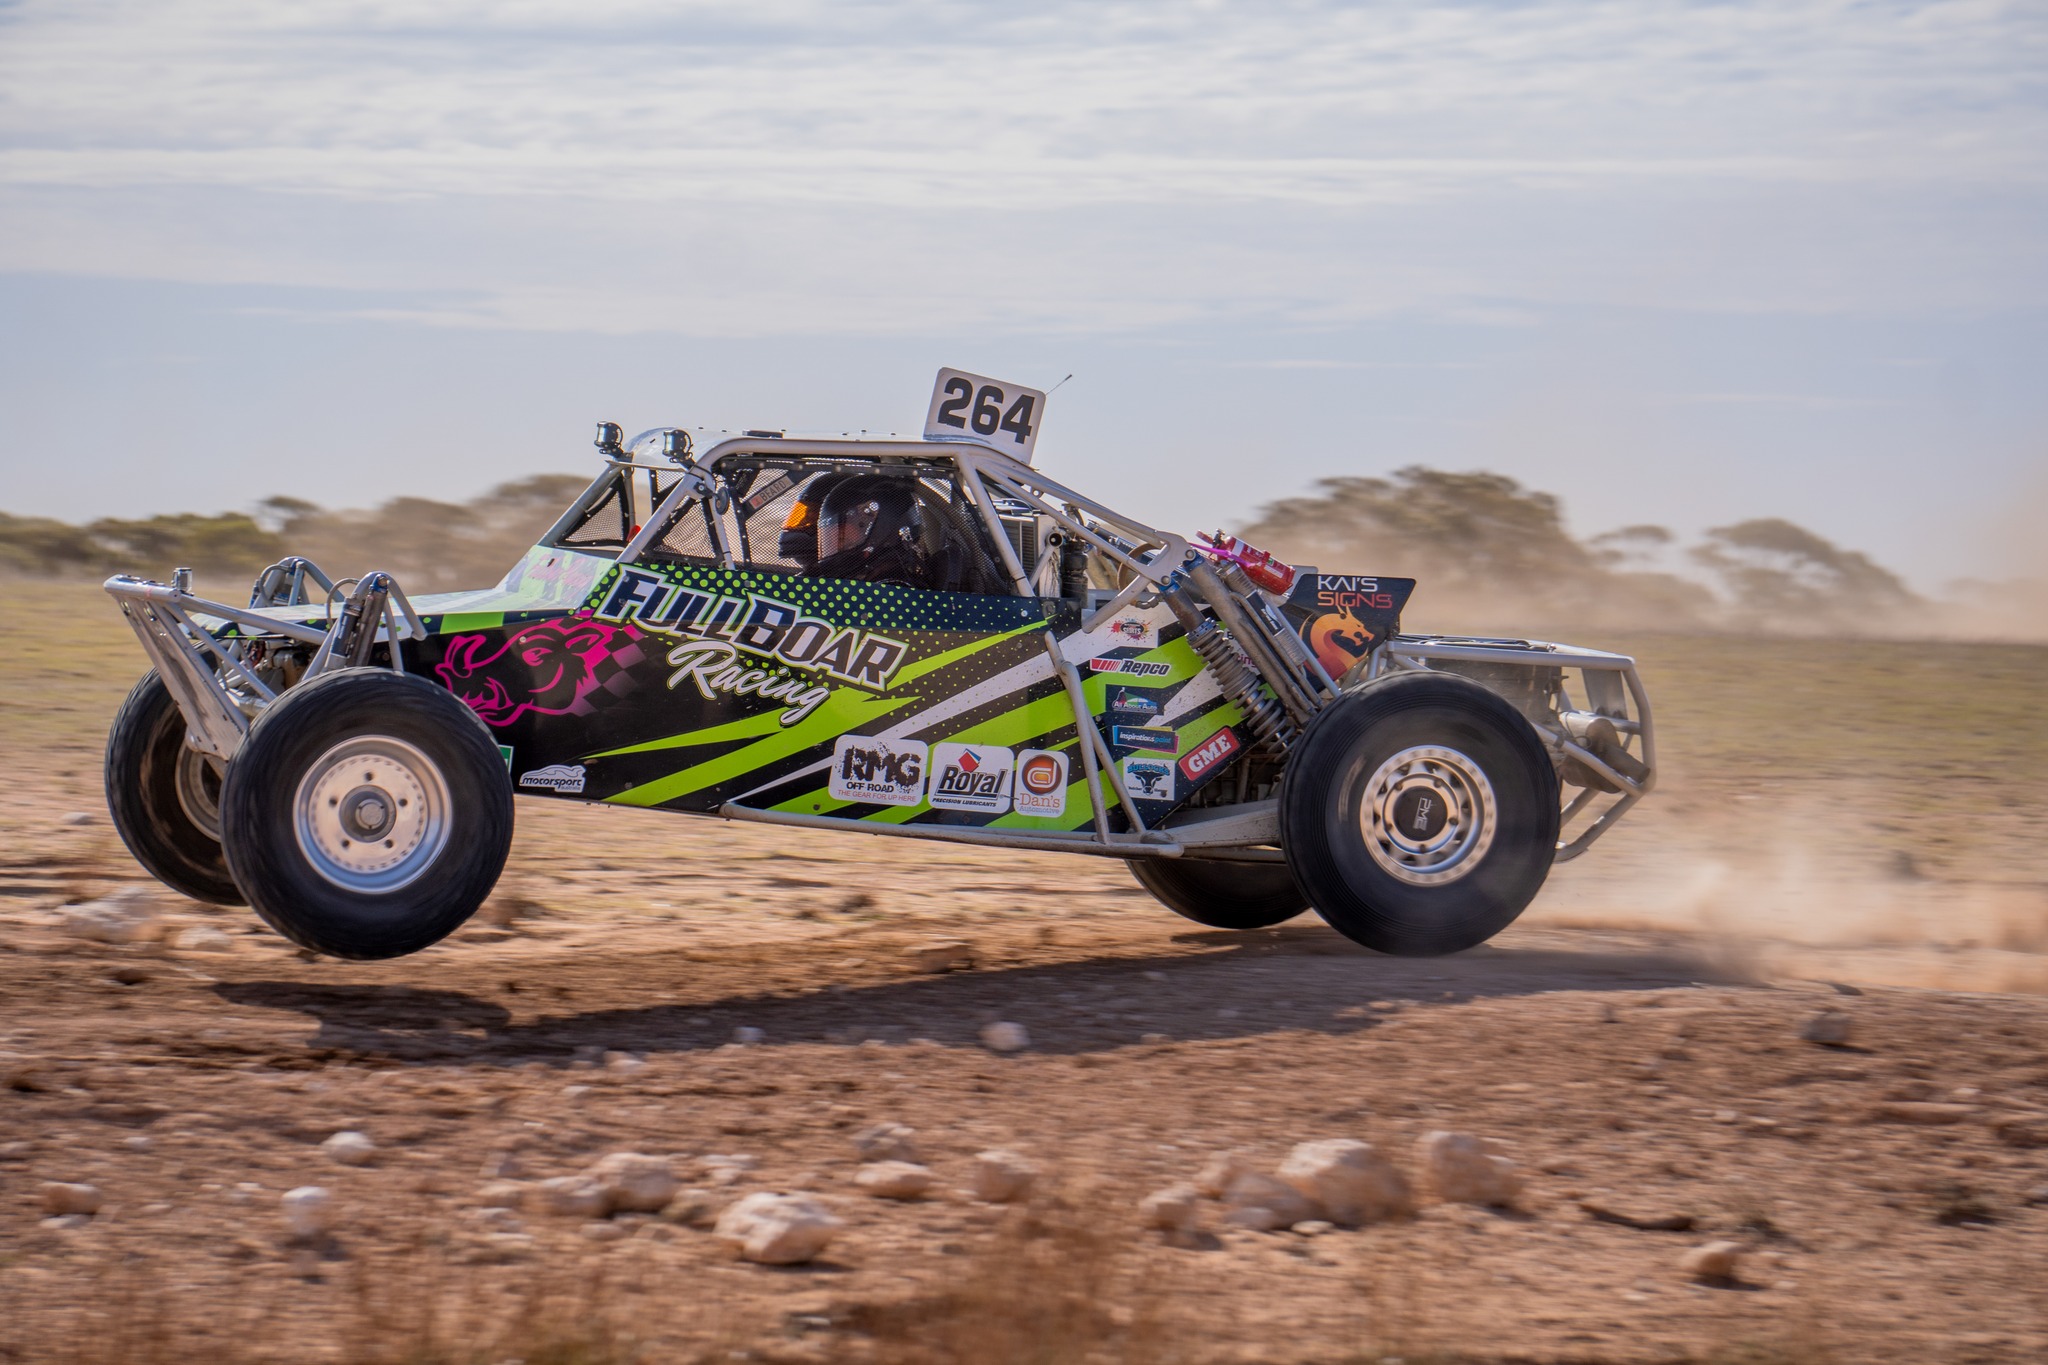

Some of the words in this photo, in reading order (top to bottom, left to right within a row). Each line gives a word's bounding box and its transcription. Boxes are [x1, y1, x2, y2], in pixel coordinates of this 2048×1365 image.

[938, 377, 1035, 444] 264
[760, 480, 787, 502] BEARD
[1317, 575, 1379, 593] KAI'S
[1317, 591, 1393, 609] SIGNS
[1120, 659, 1171, 676] Repco
[666, 640, 831, 728] Racing
[1188, 734, 1232, 773] GME
[841, 746, 921, 786] RMG
[522, 777, 582, 789] motorsport
[846, 781, 865, 790] OFF
[867, 783, 895, 793] ROAD
[936, 765, 1008, 799] Royal
[838, 789, 851, 797] THE
[852, 791, 872, 799] GEAR
[1019, 792, 1061, 809] Dan's
[962, 800, 997, 808] LUBRICANTS
